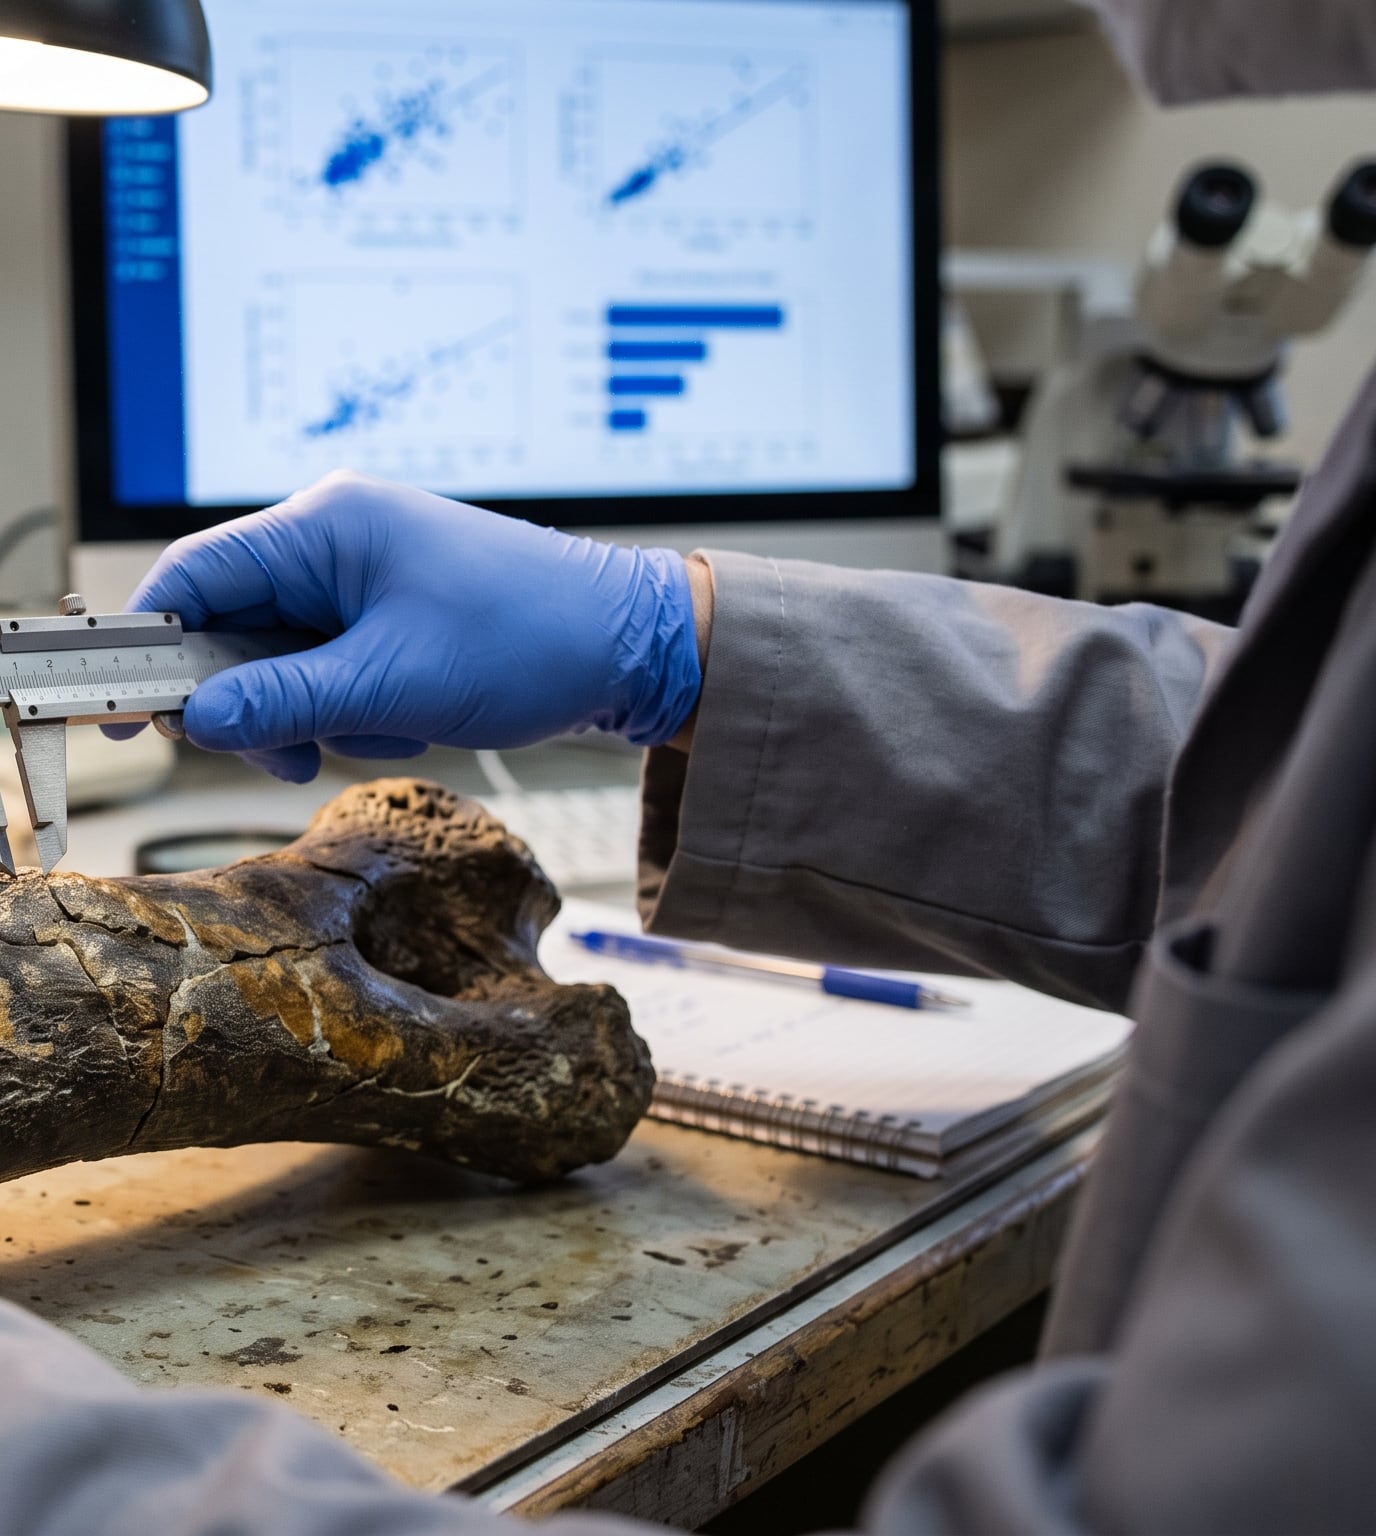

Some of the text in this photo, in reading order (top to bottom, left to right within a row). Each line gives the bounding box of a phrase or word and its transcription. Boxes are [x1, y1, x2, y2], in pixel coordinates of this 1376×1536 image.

[12, 661, 18, 671] 1
[46, 659, 53, 668] 2
[80, 657, 87, 666] 3
[113, 655, 120, 663] 4
